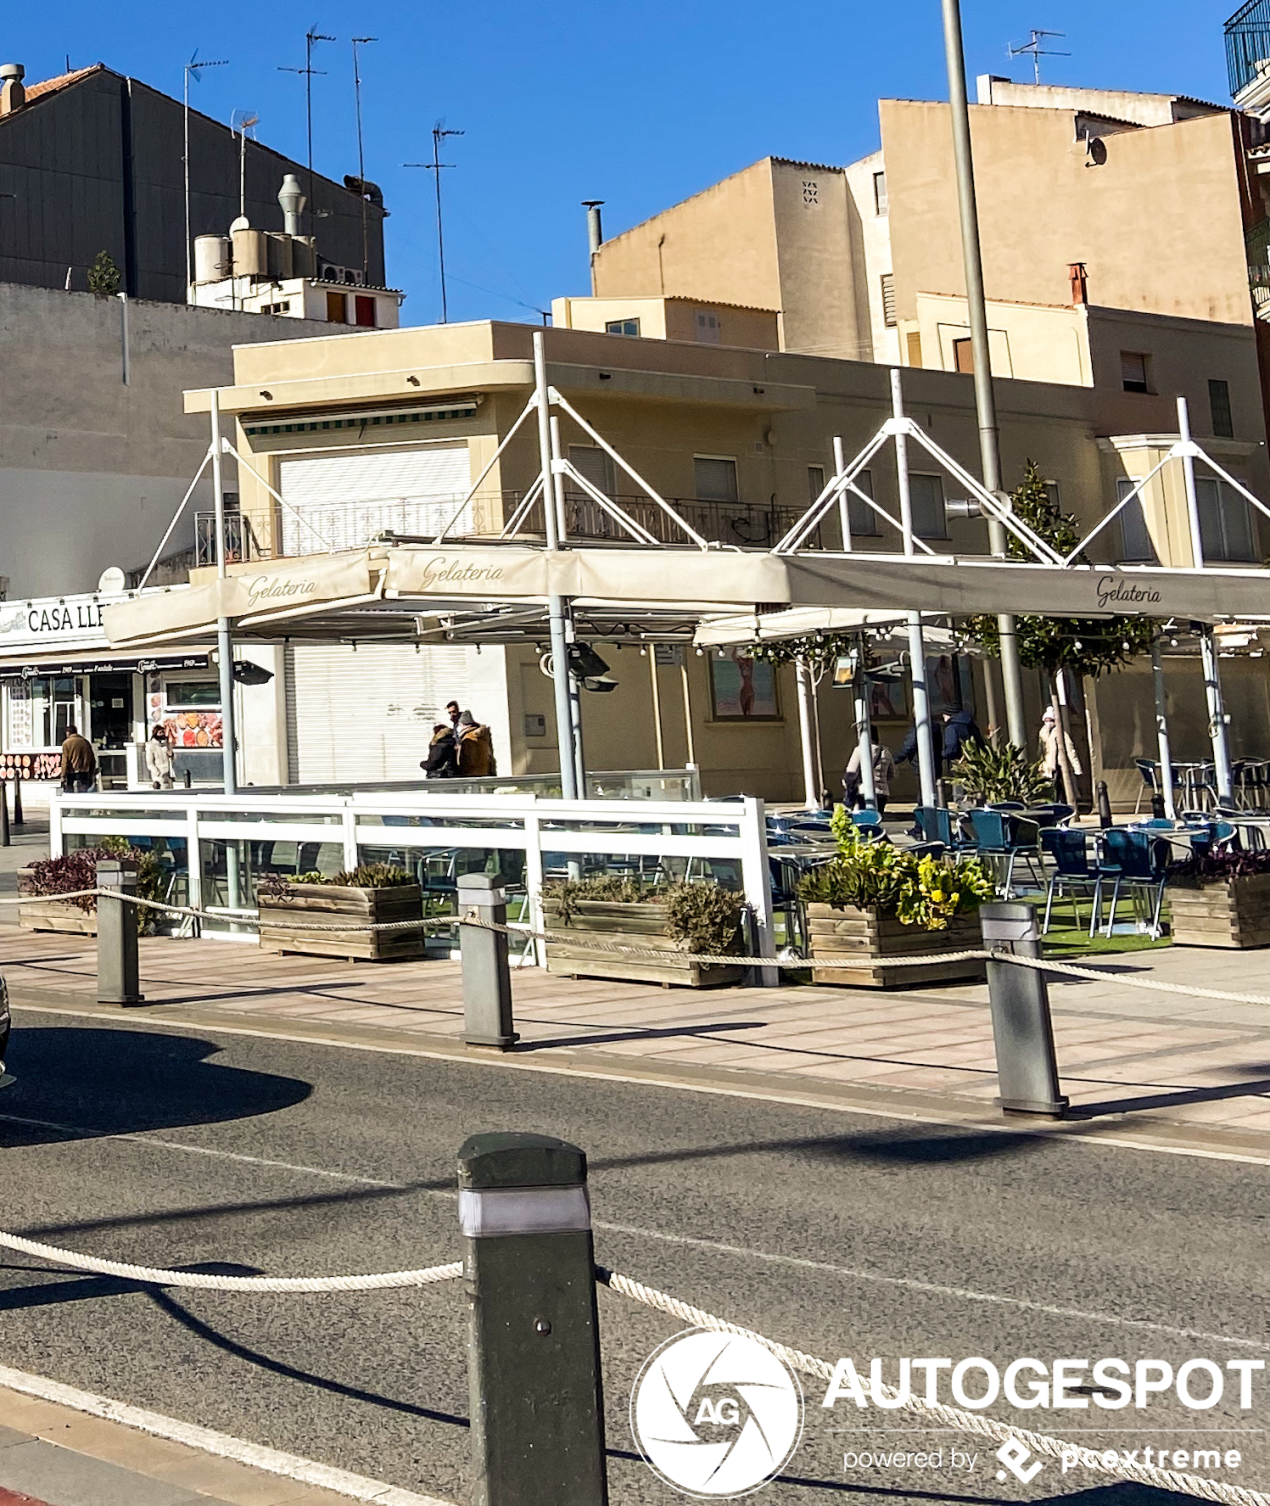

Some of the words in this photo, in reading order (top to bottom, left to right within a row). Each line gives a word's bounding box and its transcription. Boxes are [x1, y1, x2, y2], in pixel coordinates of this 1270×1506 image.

[423, 556, 504, 589] Gelateria
[248, 575, 317, 606] Gelateria
[1097, 575, 1162, 608] Gelateria
[28, 604, 74, 633] CASA
